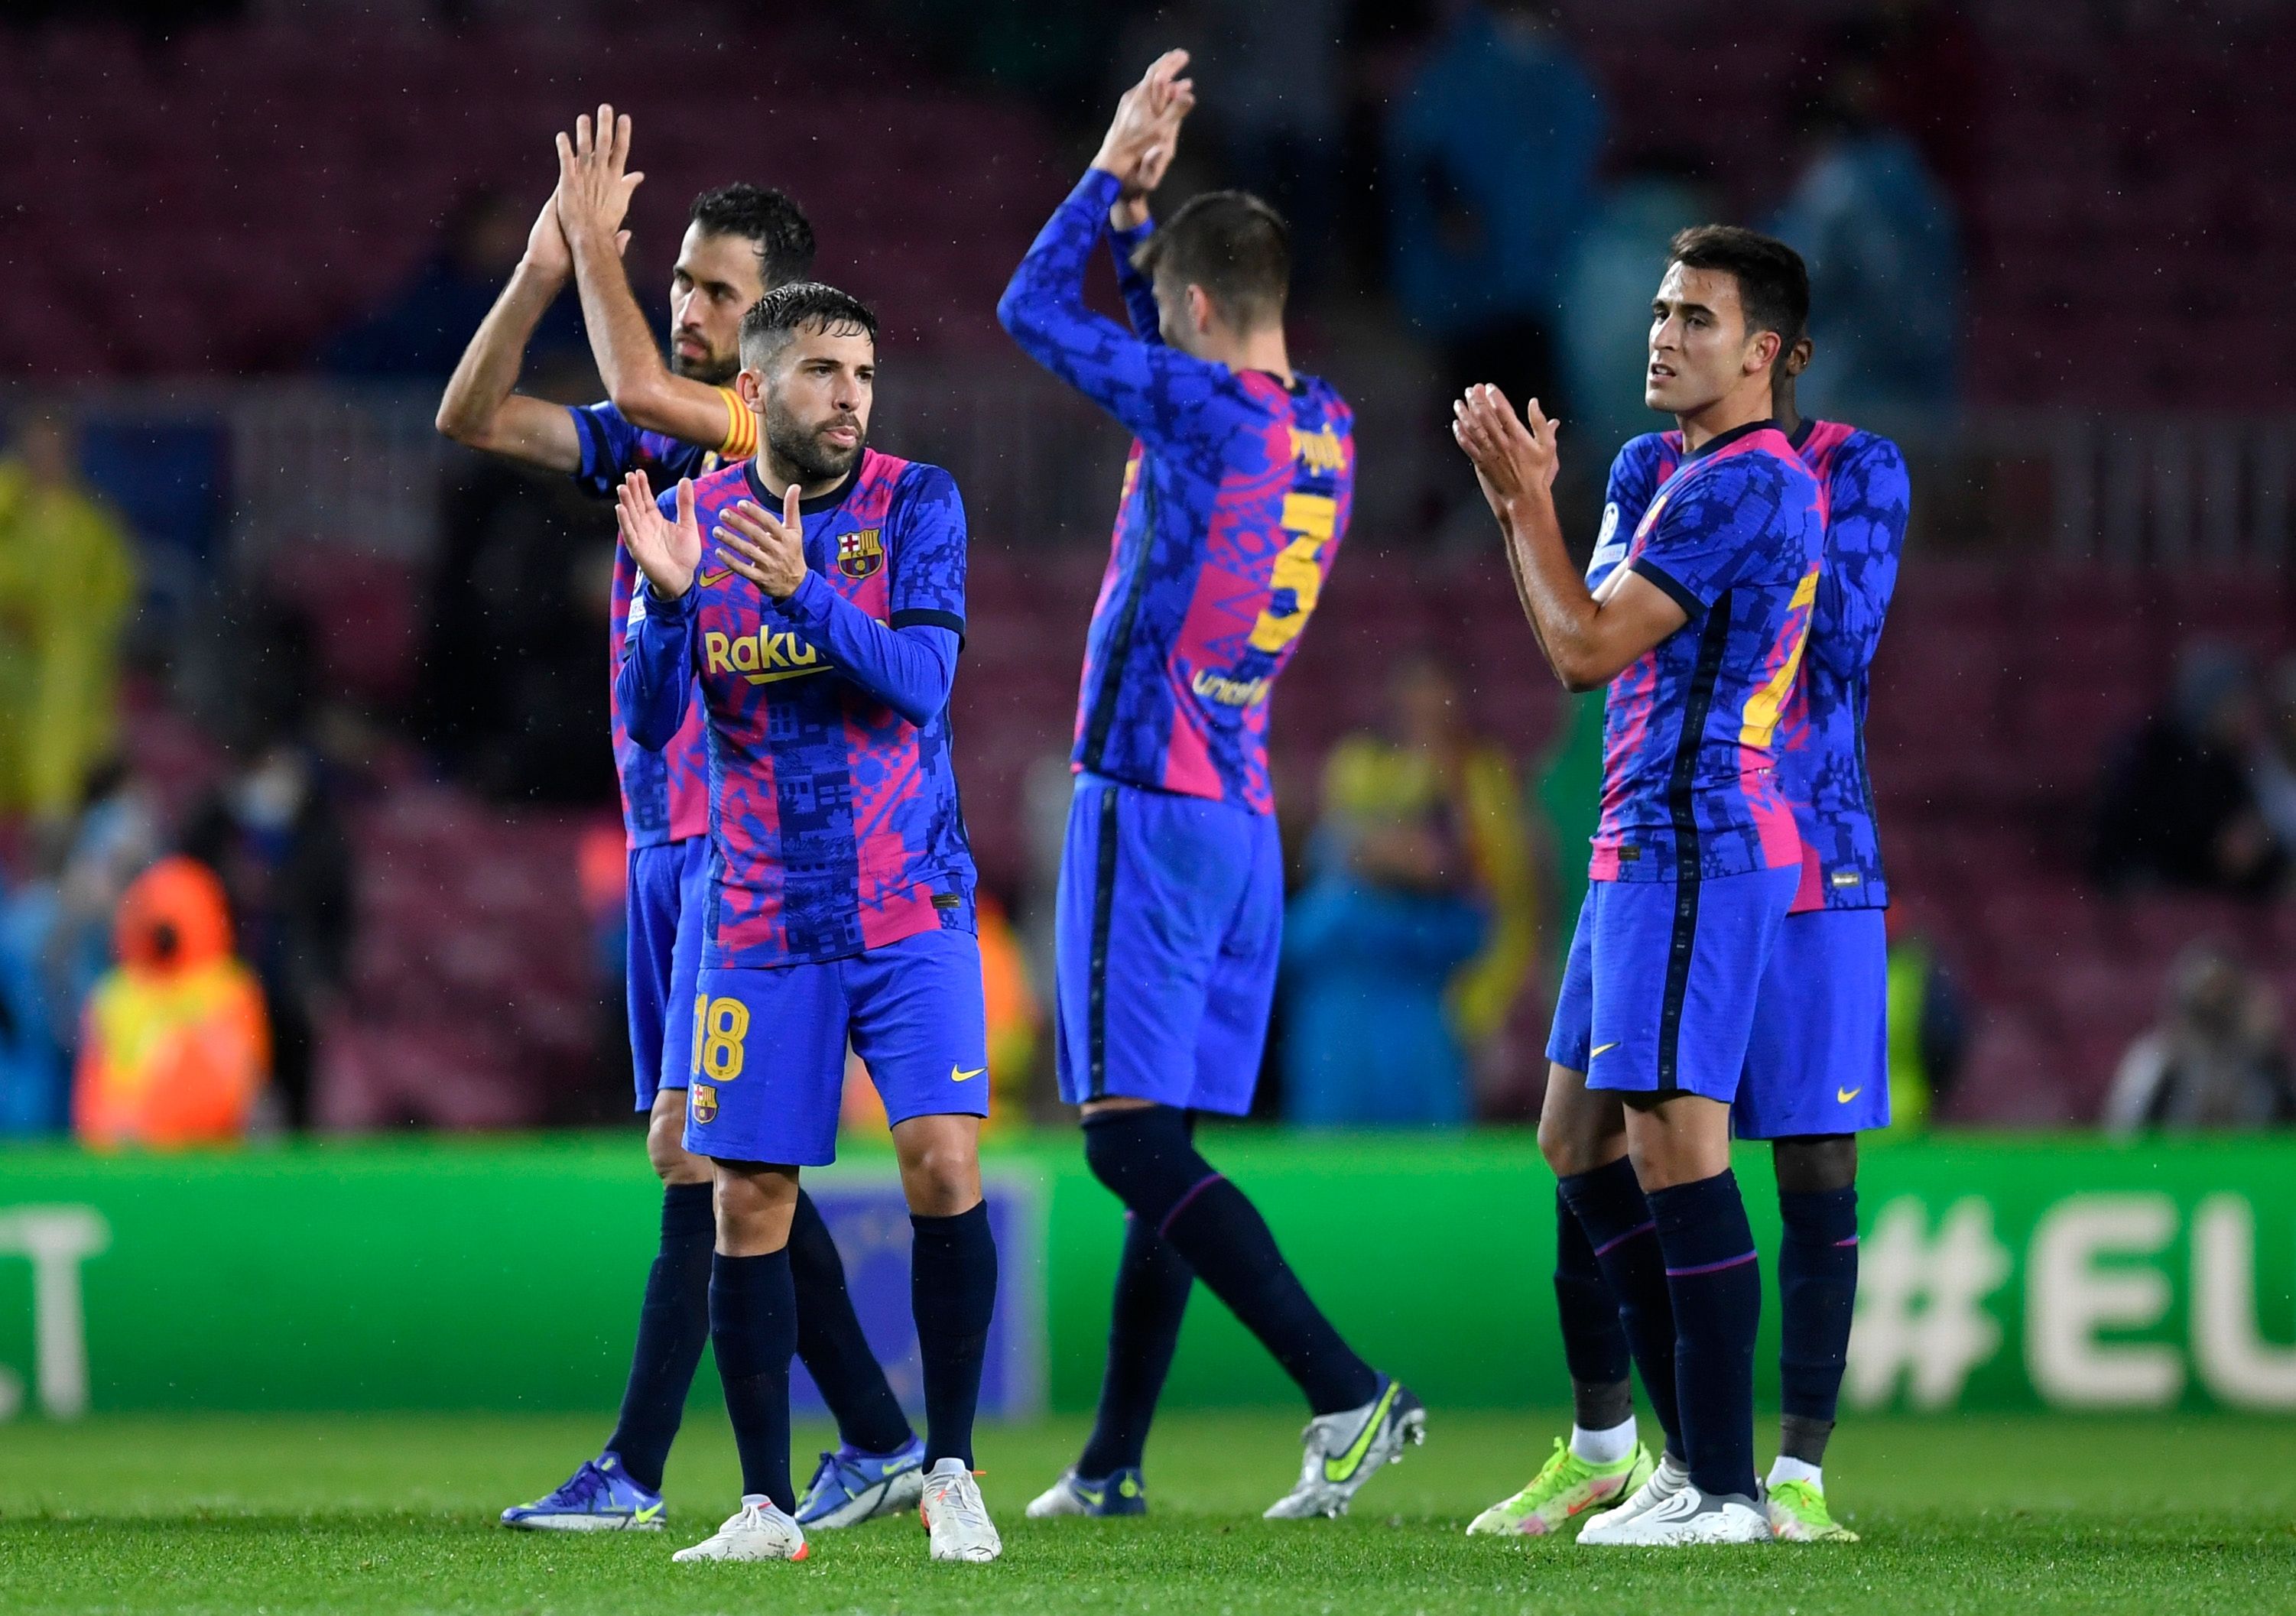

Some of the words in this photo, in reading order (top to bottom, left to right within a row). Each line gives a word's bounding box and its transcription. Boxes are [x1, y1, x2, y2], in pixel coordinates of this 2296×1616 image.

[705, 625, 817, 674] Raku
[693, 993, 750, 1082] 18
[0, 1202, 112, 1423] T
